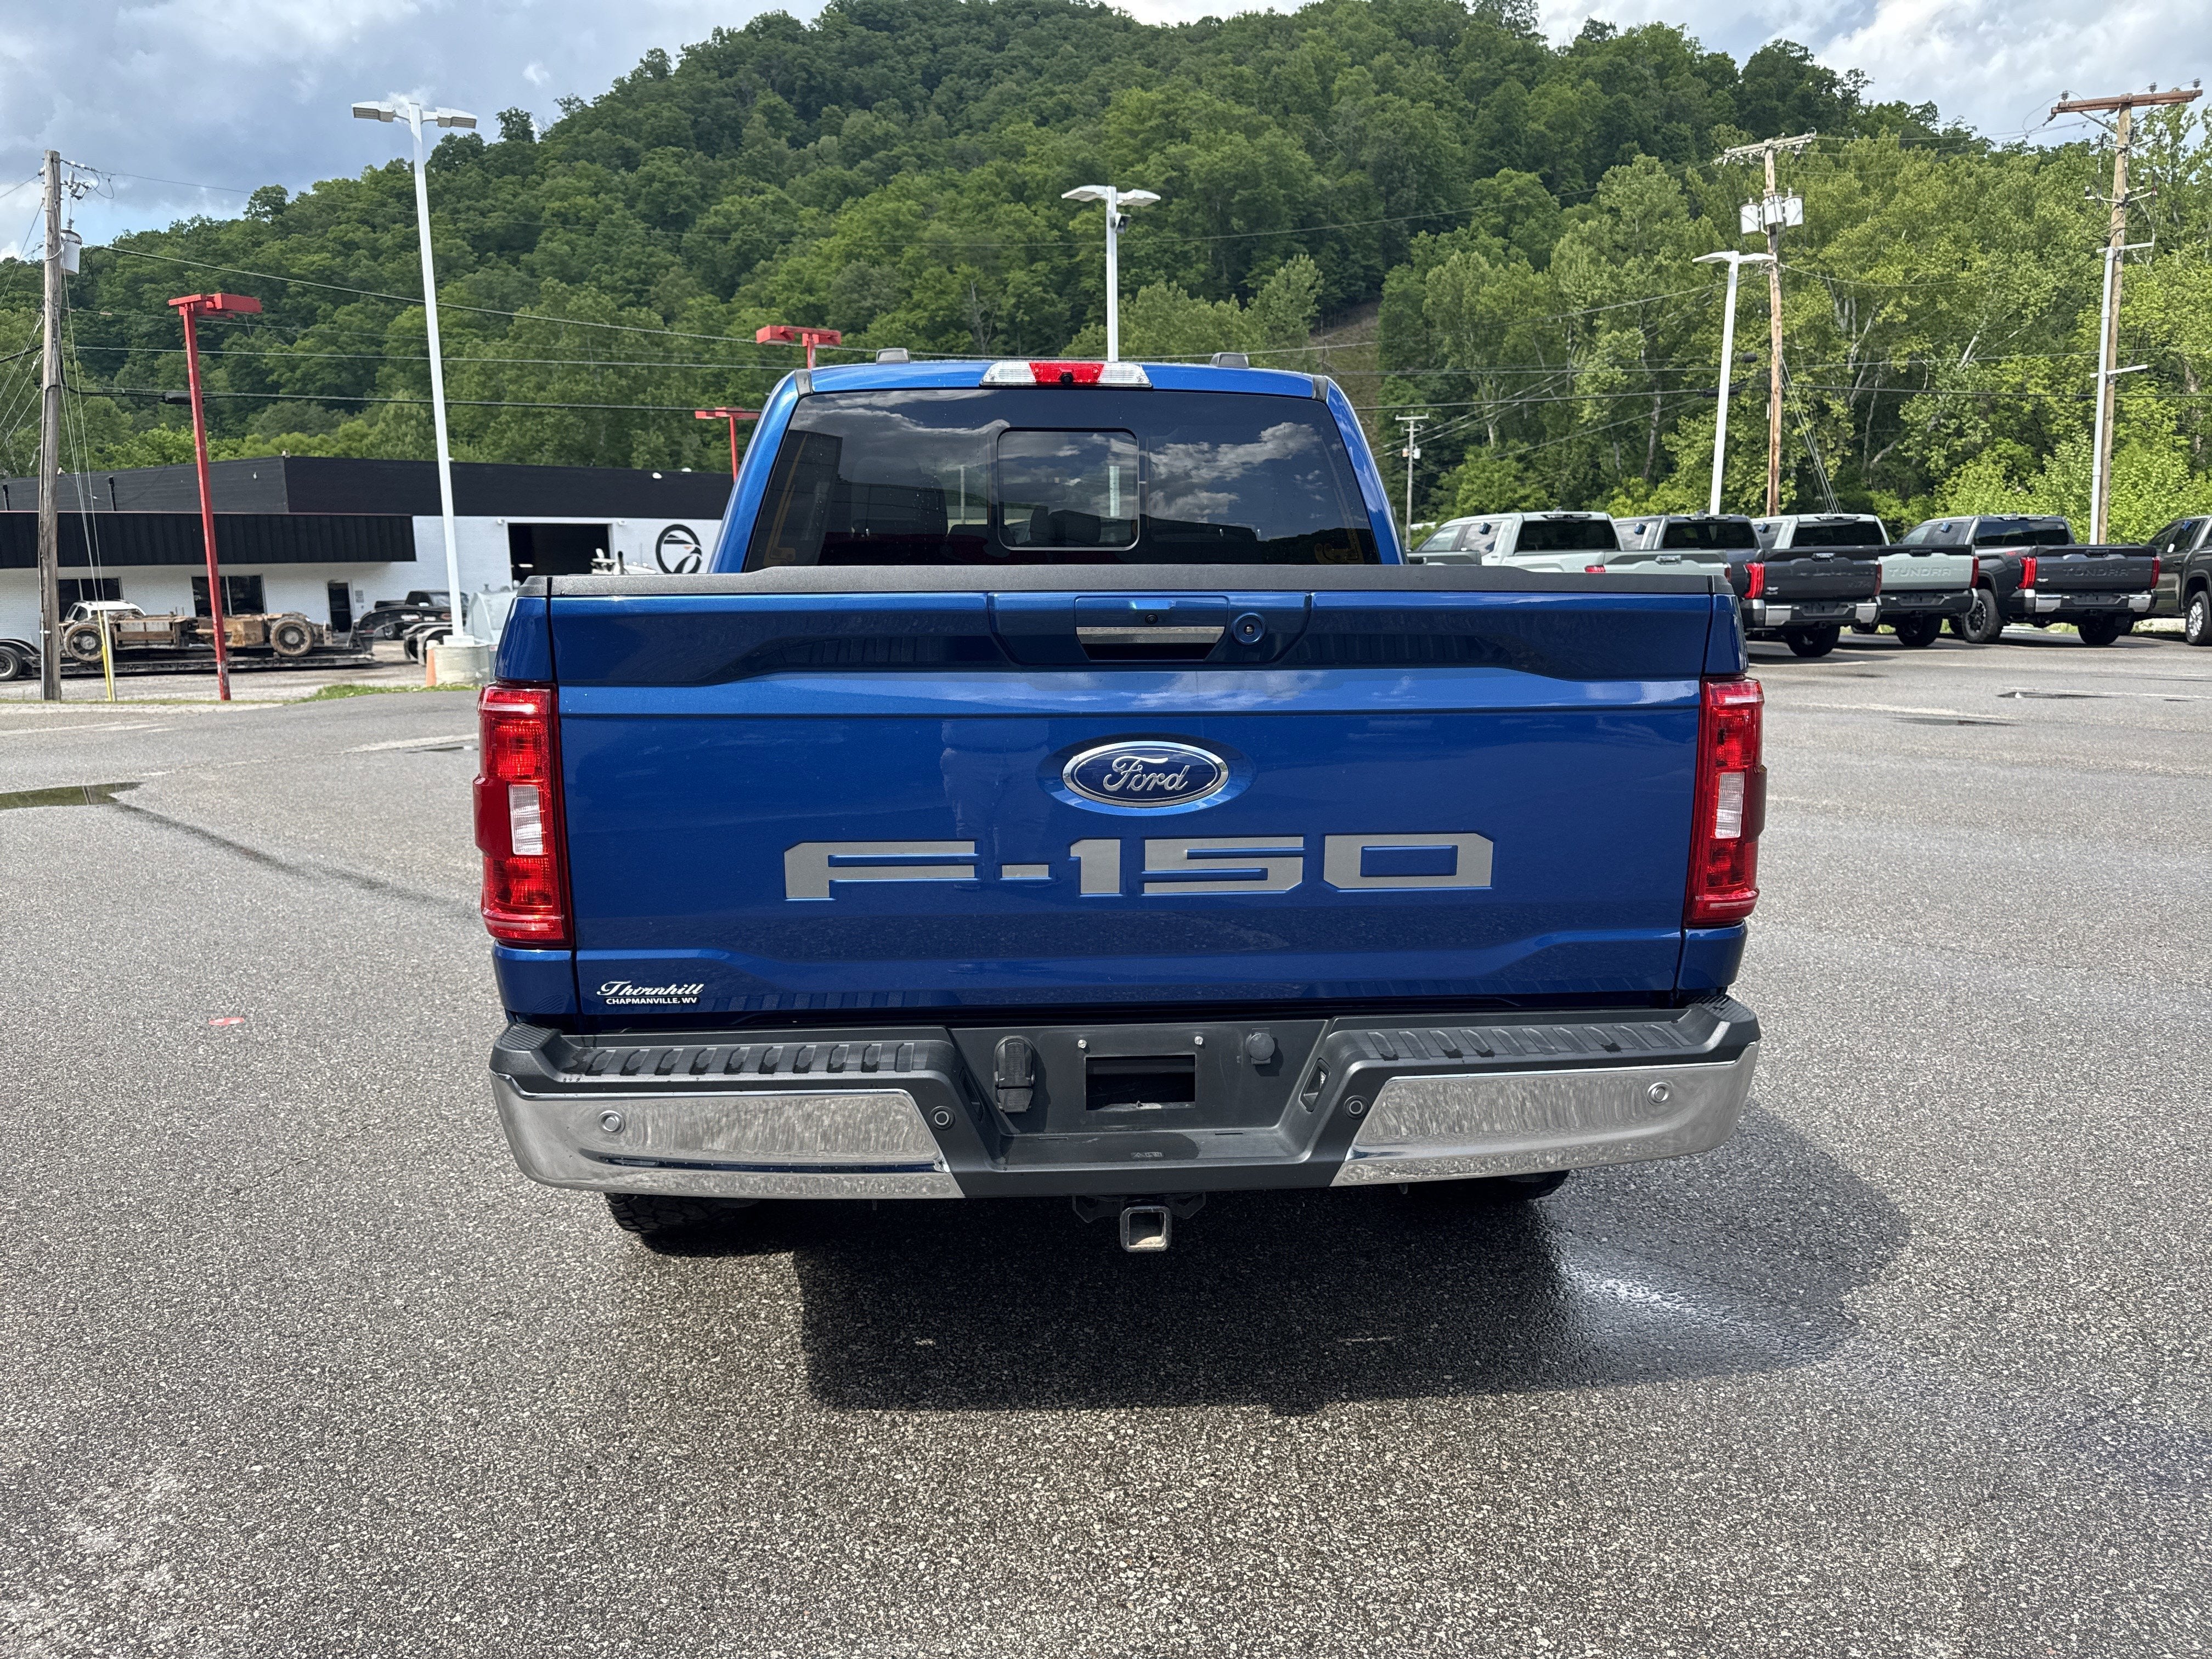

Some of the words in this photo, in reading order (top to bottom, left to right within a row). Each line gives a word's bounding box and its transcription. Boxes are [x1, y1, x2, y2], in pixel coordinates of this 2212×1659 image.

[1888, 567, 1951, 577] TUNDRA
[2063, 567, 2129, 577] TUNDRA
[1103, 755, 1190, 792] Ford
[784, 833, 1494, 901] F-150
[596, 980, 704, 996] Thornhill
